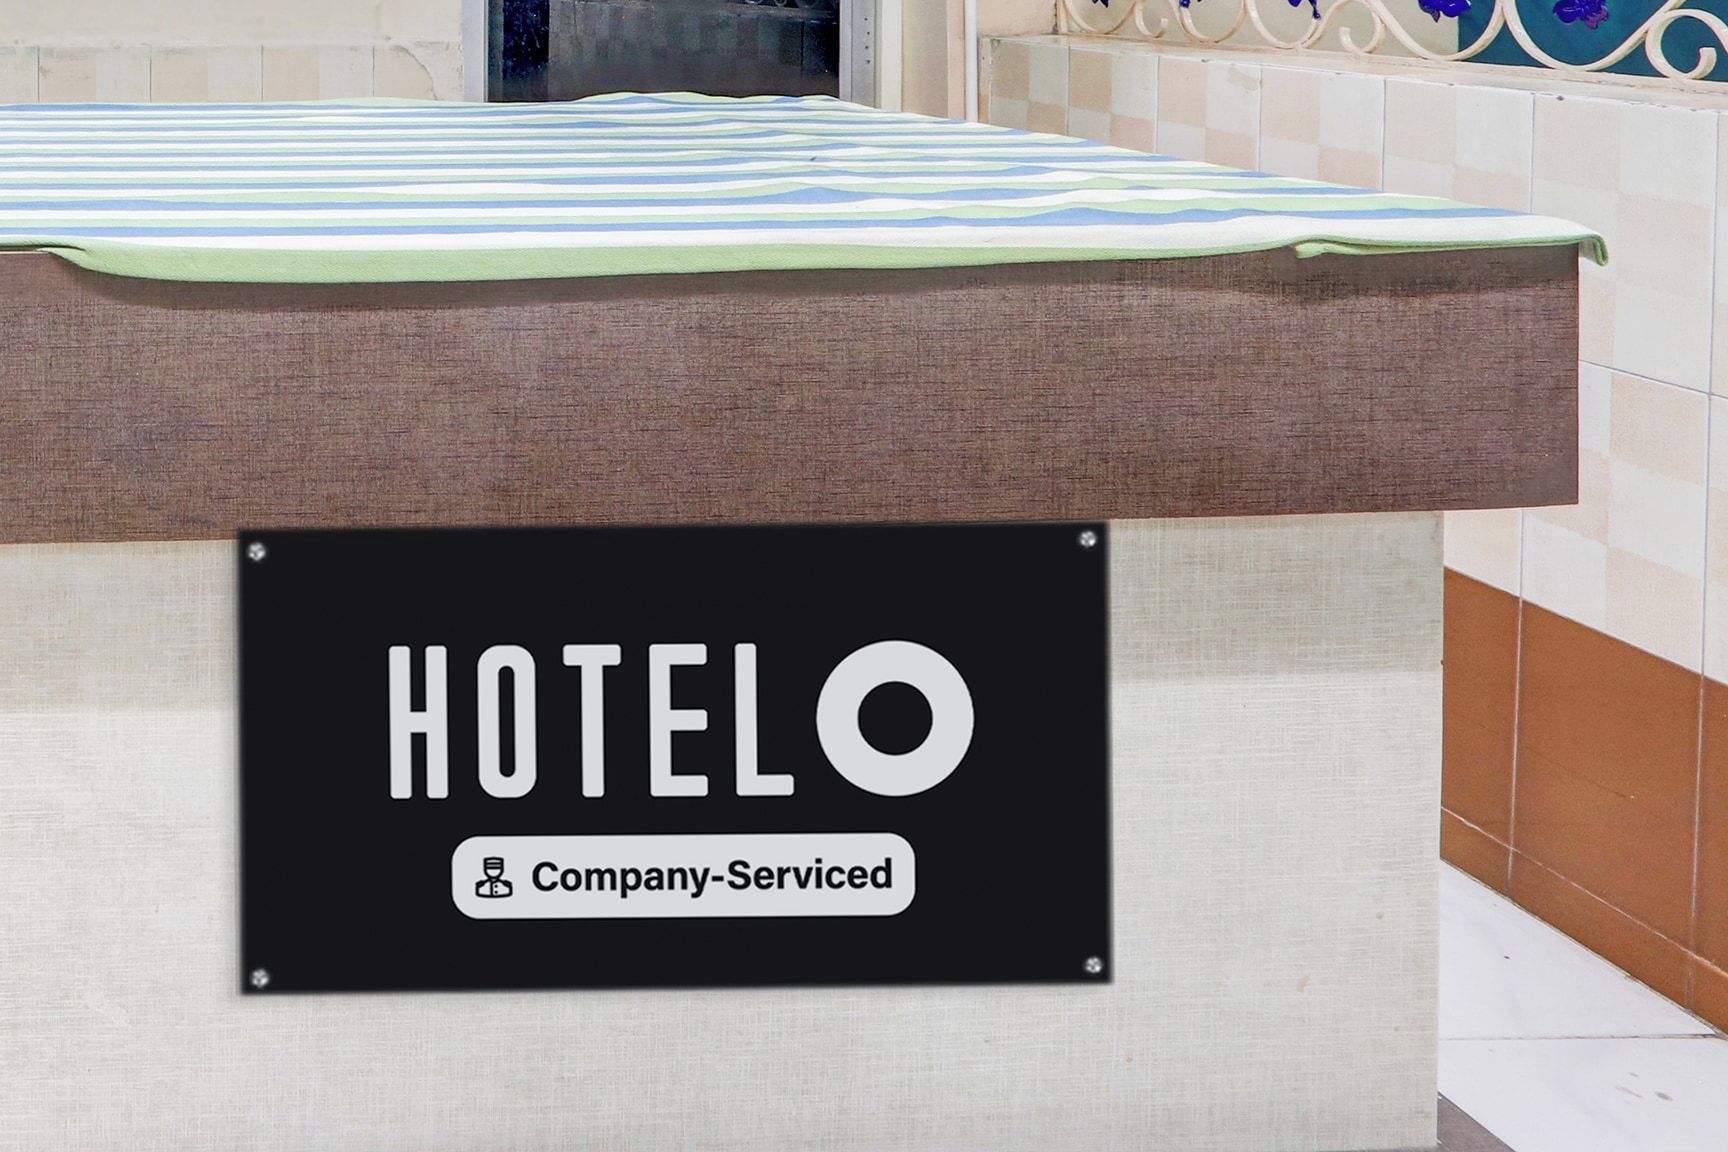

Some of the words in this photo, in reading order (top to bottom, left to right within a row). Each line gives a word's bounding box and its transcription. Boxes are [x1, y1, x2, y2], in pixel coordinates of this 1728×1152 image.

[388, 642, 796, 800] HOTEL
[815, 639, 976, 798] O
[530, 858, 894, 899] Company-Serviced
